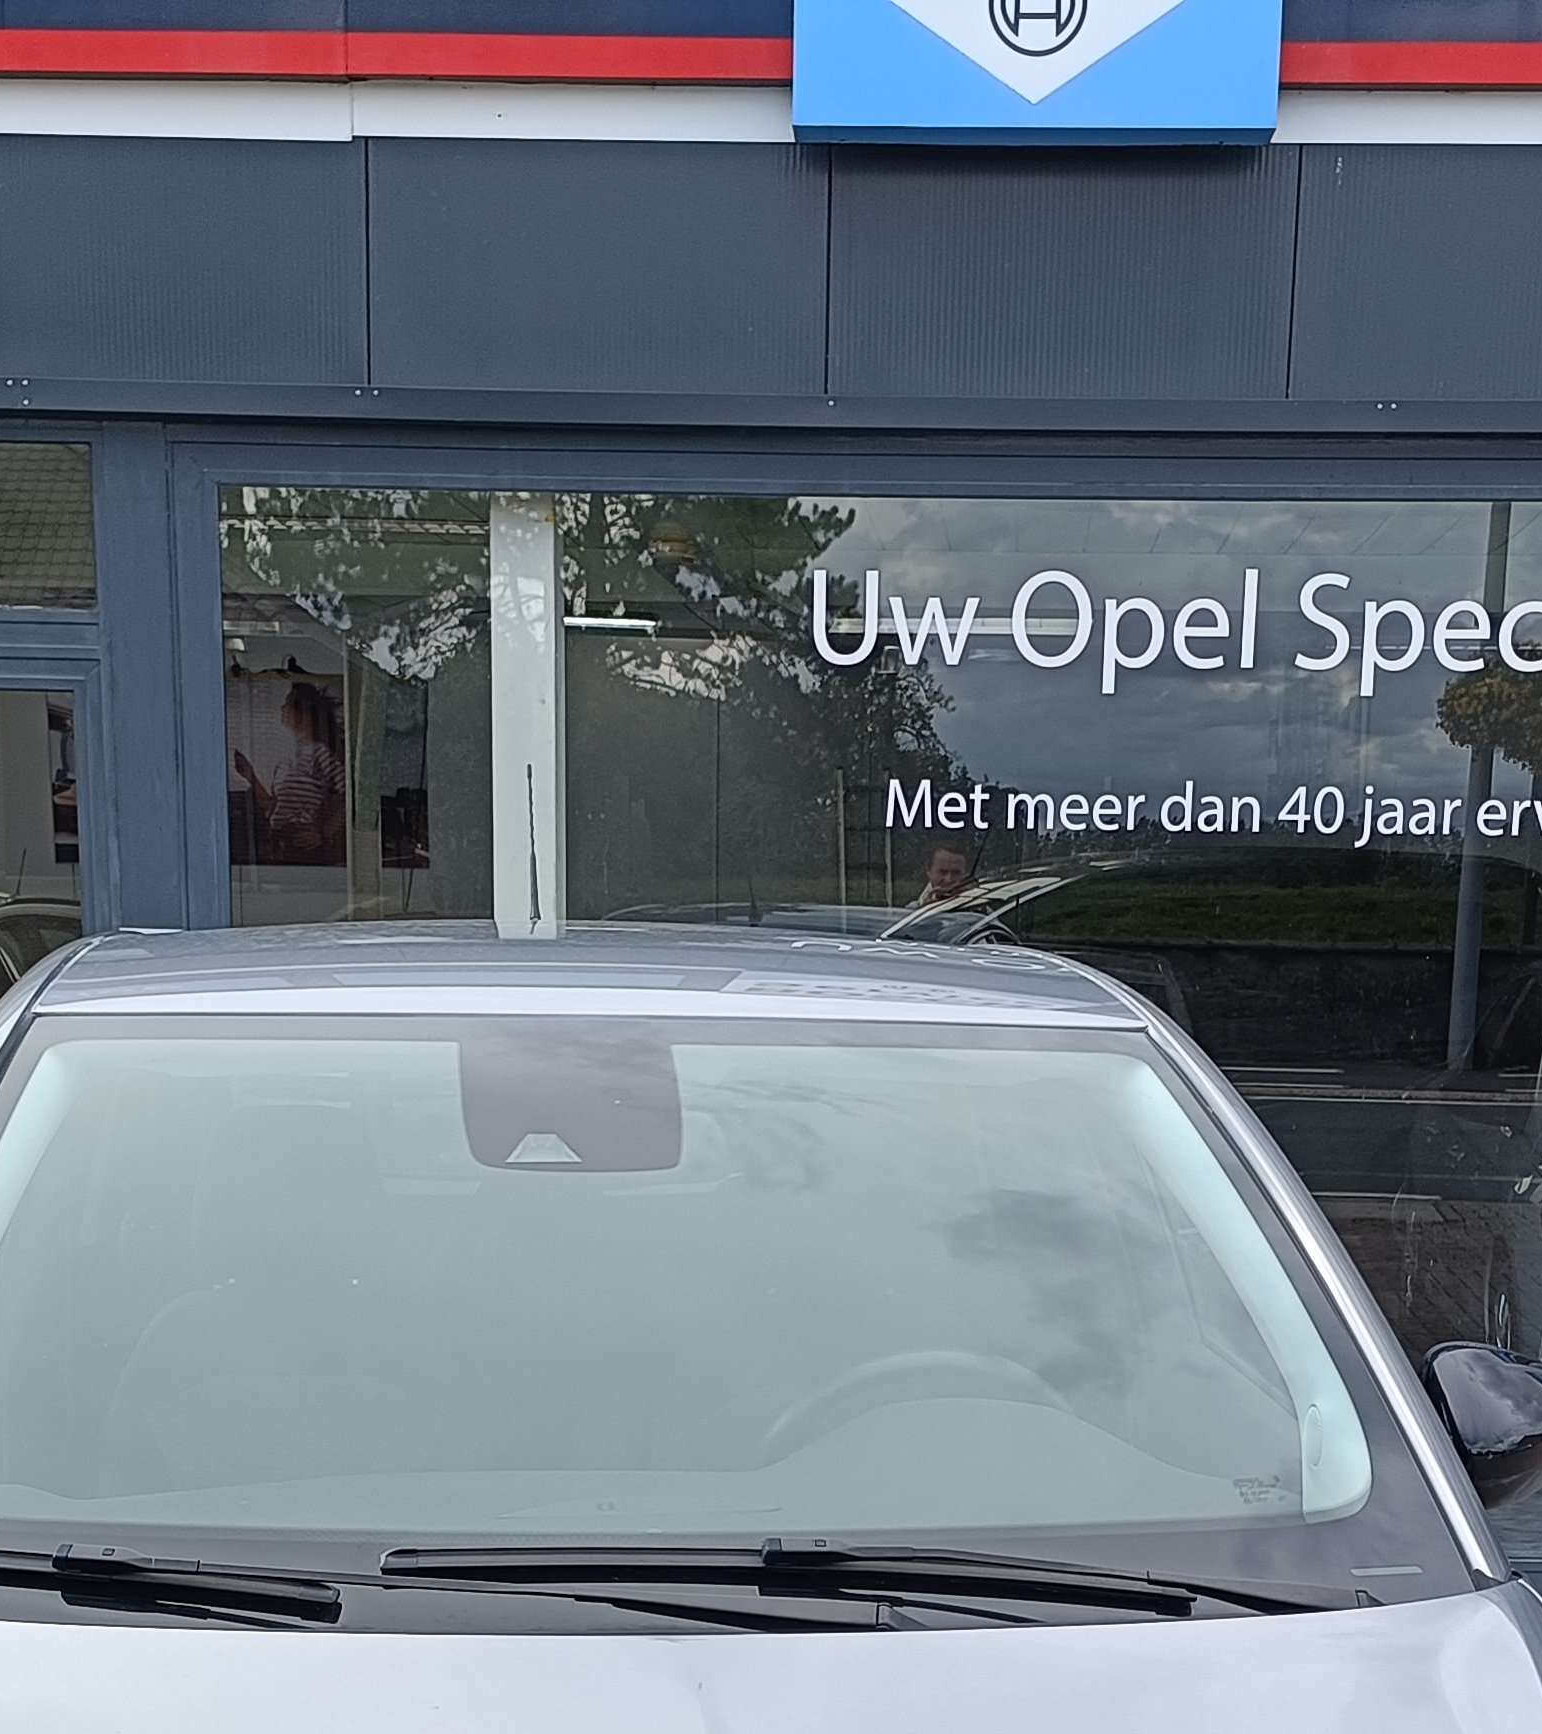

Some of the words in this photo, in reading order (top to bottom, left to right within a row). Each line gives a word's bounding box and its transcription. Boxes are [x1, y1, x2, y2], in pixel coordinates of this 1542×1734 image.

[813, 569, 980, 665] Uw
[1011, 568, 1259, 694] Opel
[885, 779, 990, 829] Met
[1007, 793, 1143, 832] meer
[1160, 780, 1260, 833] dan
[1278, 786, 1344, 835] 40
[1354, 786, 1462, 849] jaar
